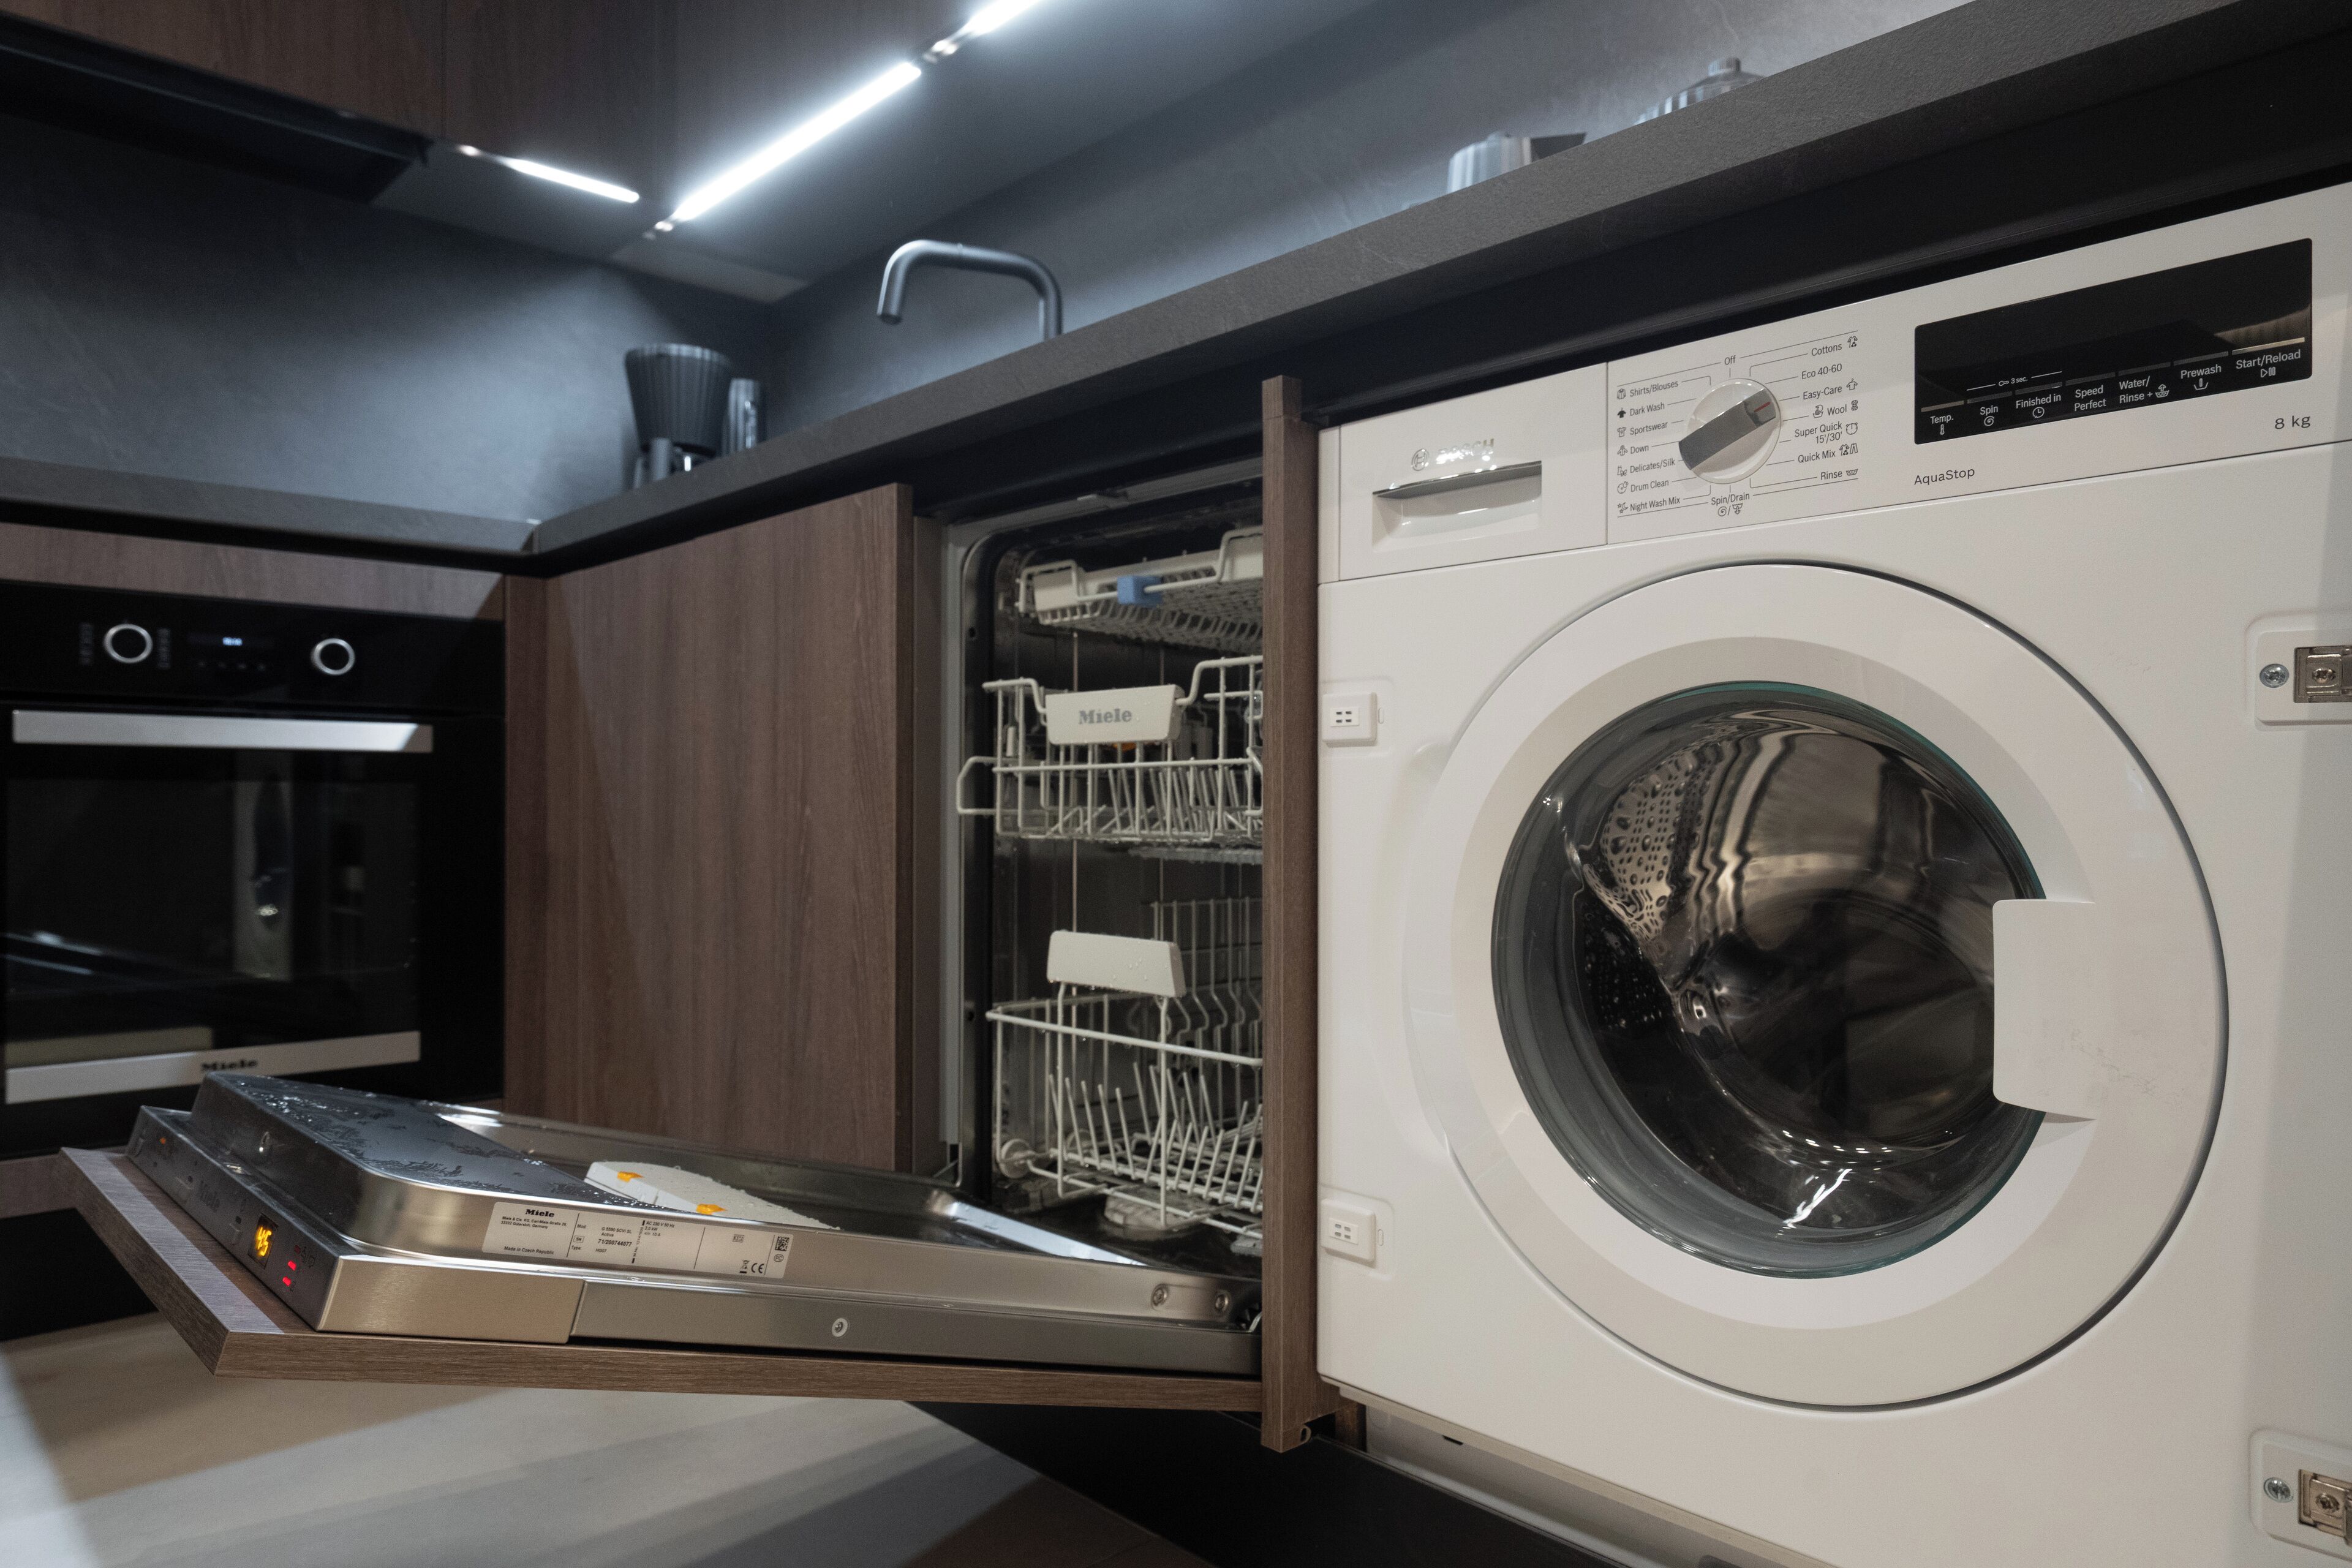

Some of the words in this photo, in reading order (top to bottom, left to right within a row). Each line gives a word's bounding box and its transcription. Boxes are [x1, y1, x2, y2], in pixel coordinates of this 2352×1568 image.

[1811, 343, 1842, 356] Cottons
[1724, 355, 1736, 365] Off
[2236, 349, 2301, 369] Start/Reload
[1801, 369, 1815, 379] Eco
[1818, 363, 1842, 376] 40-60
[2180, 364, 2222, 379] Prewash
[1630, 380, 1679, 397] Shirts/Blouses
[2119, 377, 2150, 390] Water/
[1803, 385, 1842, 401] Easy-Care
[2075, 385, 2103, 399] Speed
[2119, 391, 2144, 404] Rinse
[2016, 394, 2051, 409] Finished
[2074, 399, 2106, 412] Perfect
[1630, 405, 1644, 417] Dark
[1646, 402, 1665, 413] Wash
[1827, 404, 1847, 417] Wool
[1980, 405, 1999, 415] Spin
[1931, 415, 1954, 424] Temp.
[2275, 418, 2285, 429] 8
[2291, 415, 2310, 428] kg
[1630, 421, 1668, 435] Sportswear
[1795, 426, 1817, 440] Super
[1819, 421, 1842, 434] Quick
[1630, 444, 1649, 454] Down
[1798, 451, 1820, 464] Quick
[1822, 450, 1836, 459] Mix
[1630, 458, 1675, 474] Delicates/Silk
[1820, 470, 1842, 481] Rinse
[1914, 467, 1975, 485] AquaStop
[1630, 483, 1648, 492] Drum
[1649, 478, 1669, 489] Clean
[1630, 500, 1646, 512] Night
[1648, 497, 1667, 508] Wash
[1668, 496, 1680, 505] Mix
[1711, 492, 1750, 506] Spin/Drain
[1079, 708, 1132, 725] Miele
[751, 1262, 764, 1273] CE
